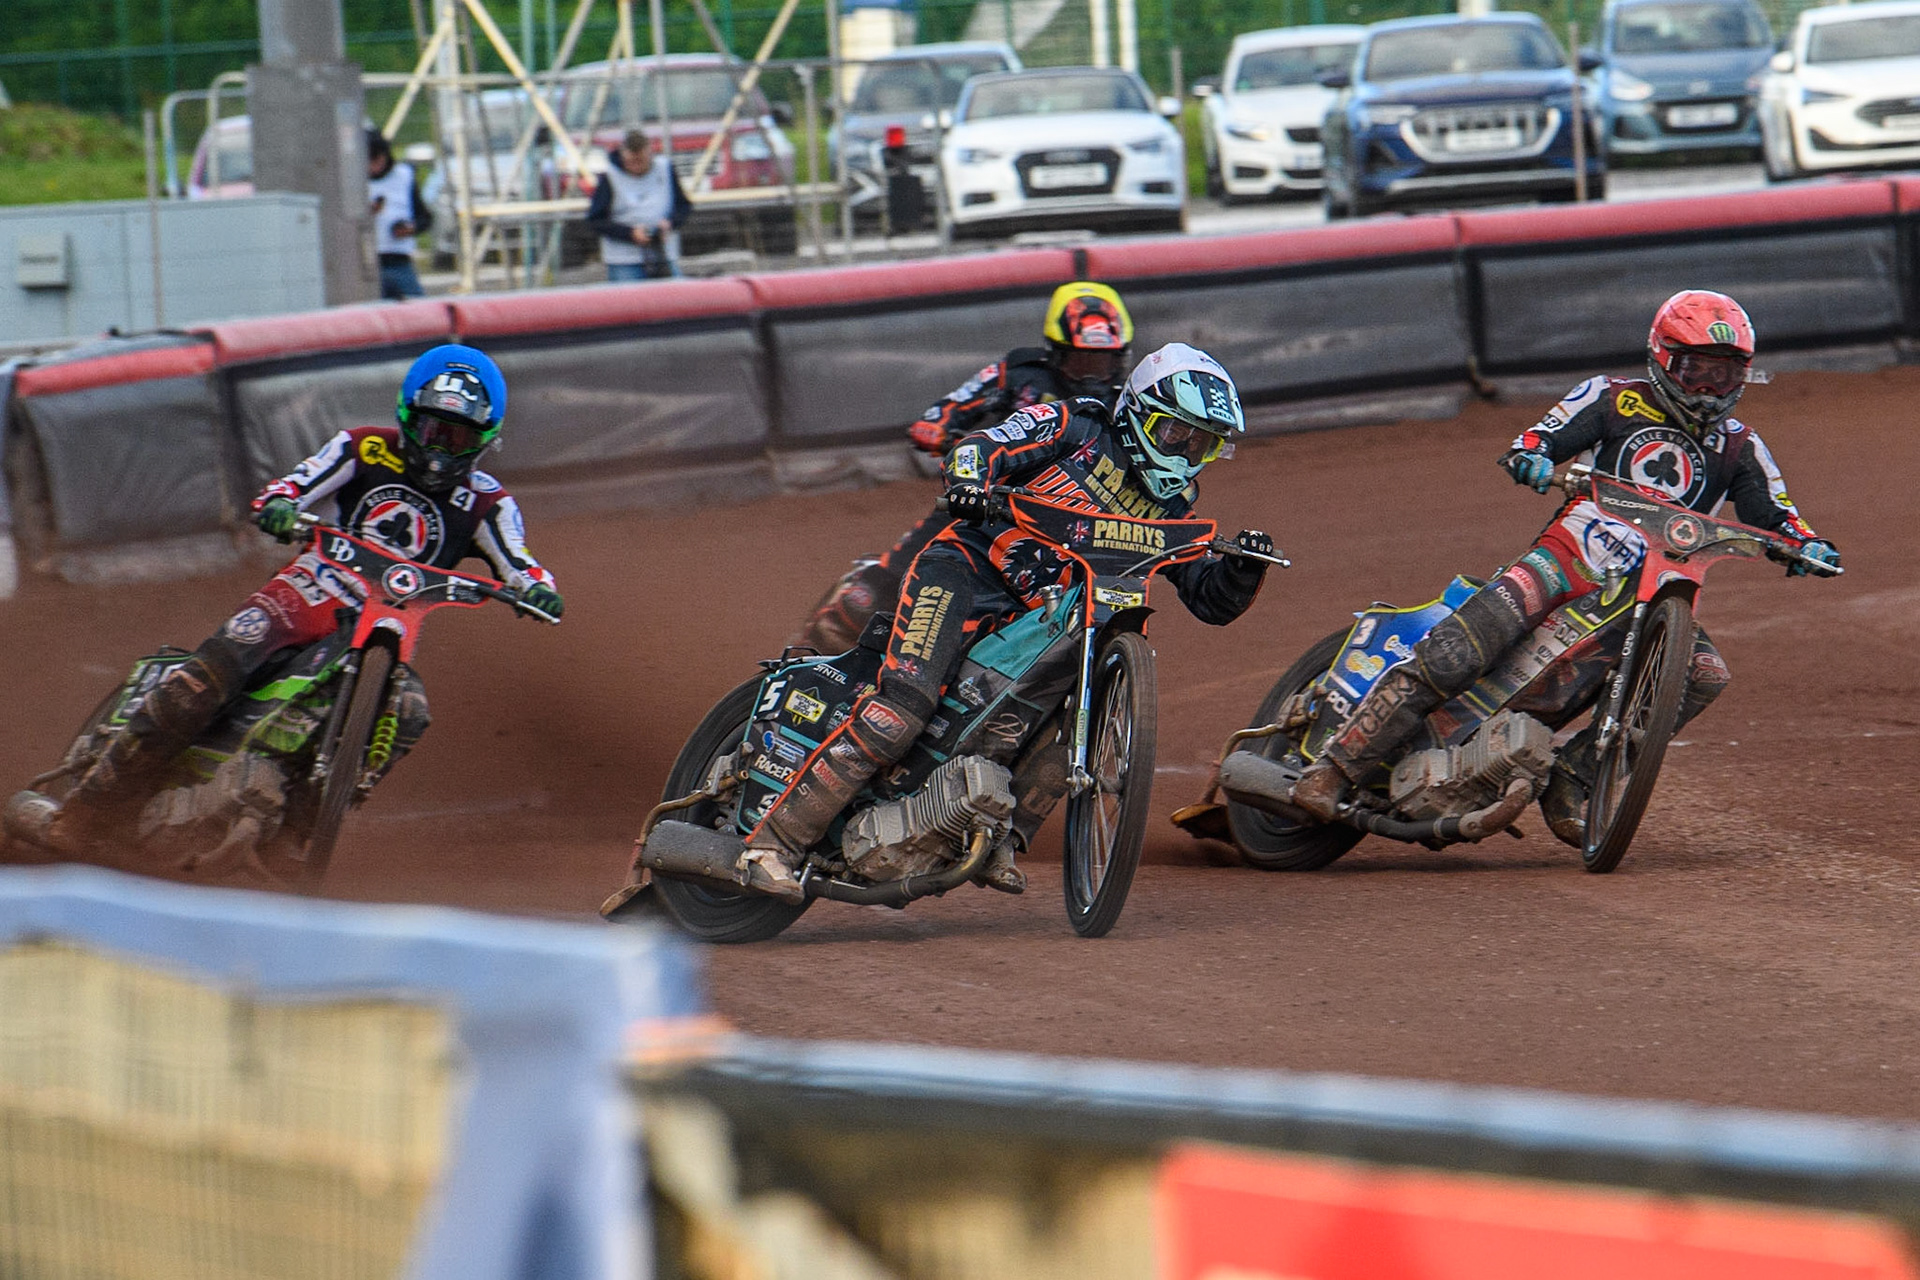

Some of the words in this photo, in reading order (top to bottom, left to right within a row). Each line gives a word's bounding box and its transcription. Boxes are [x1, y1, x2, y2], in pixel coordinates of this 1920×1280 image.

[1628, 431, 1663, 451] BELLE
[1093, 453, 1169, 520] PARRY
[1094, 520, 1166, 549] PARRYS
[900, 585, 944, 657] PARRYS
[921, 590, 954, 661] INTERNATIONAL
[758, 680, 788, 712] 5
